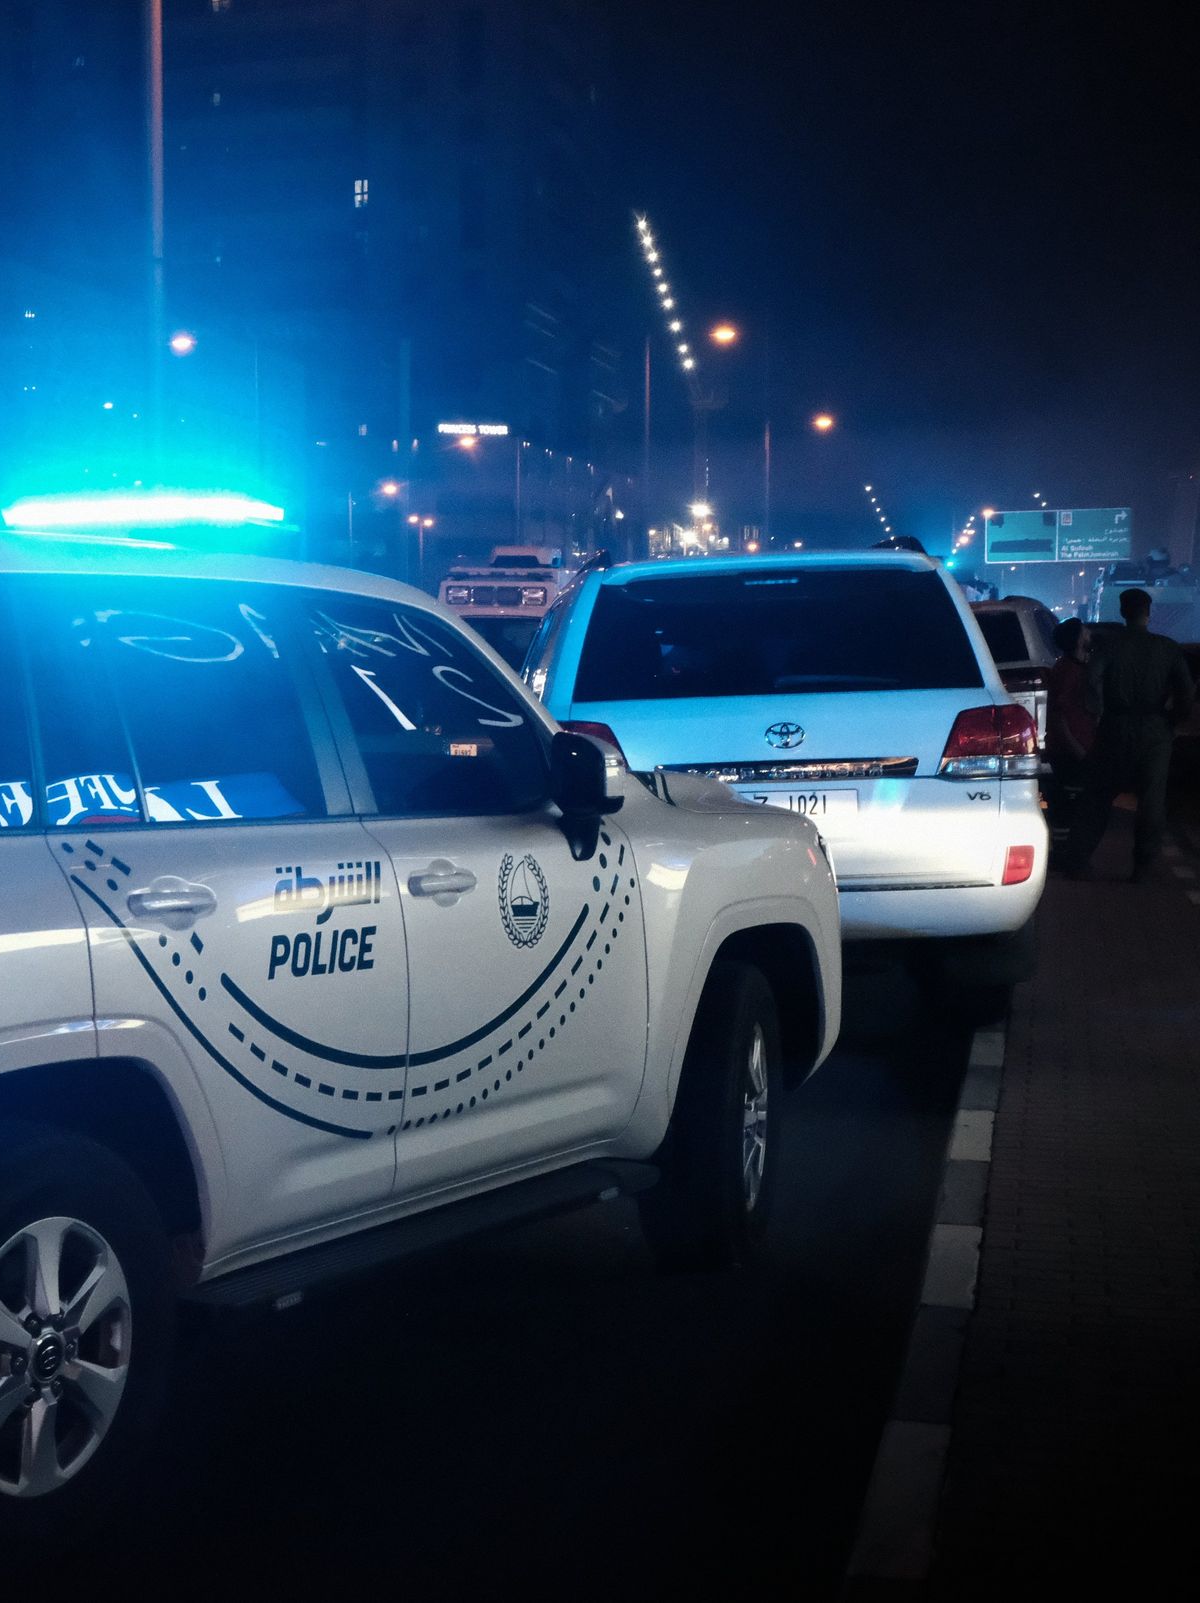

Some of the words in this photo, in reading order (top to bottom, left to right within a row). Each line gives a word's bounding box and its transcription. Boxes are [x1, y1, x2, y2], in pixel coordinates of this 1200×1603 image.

[478, 425, 508, 435] TOWER
[274, 861, 381, 926] الشرطة
[267, 925, 377, 981] POLICE
